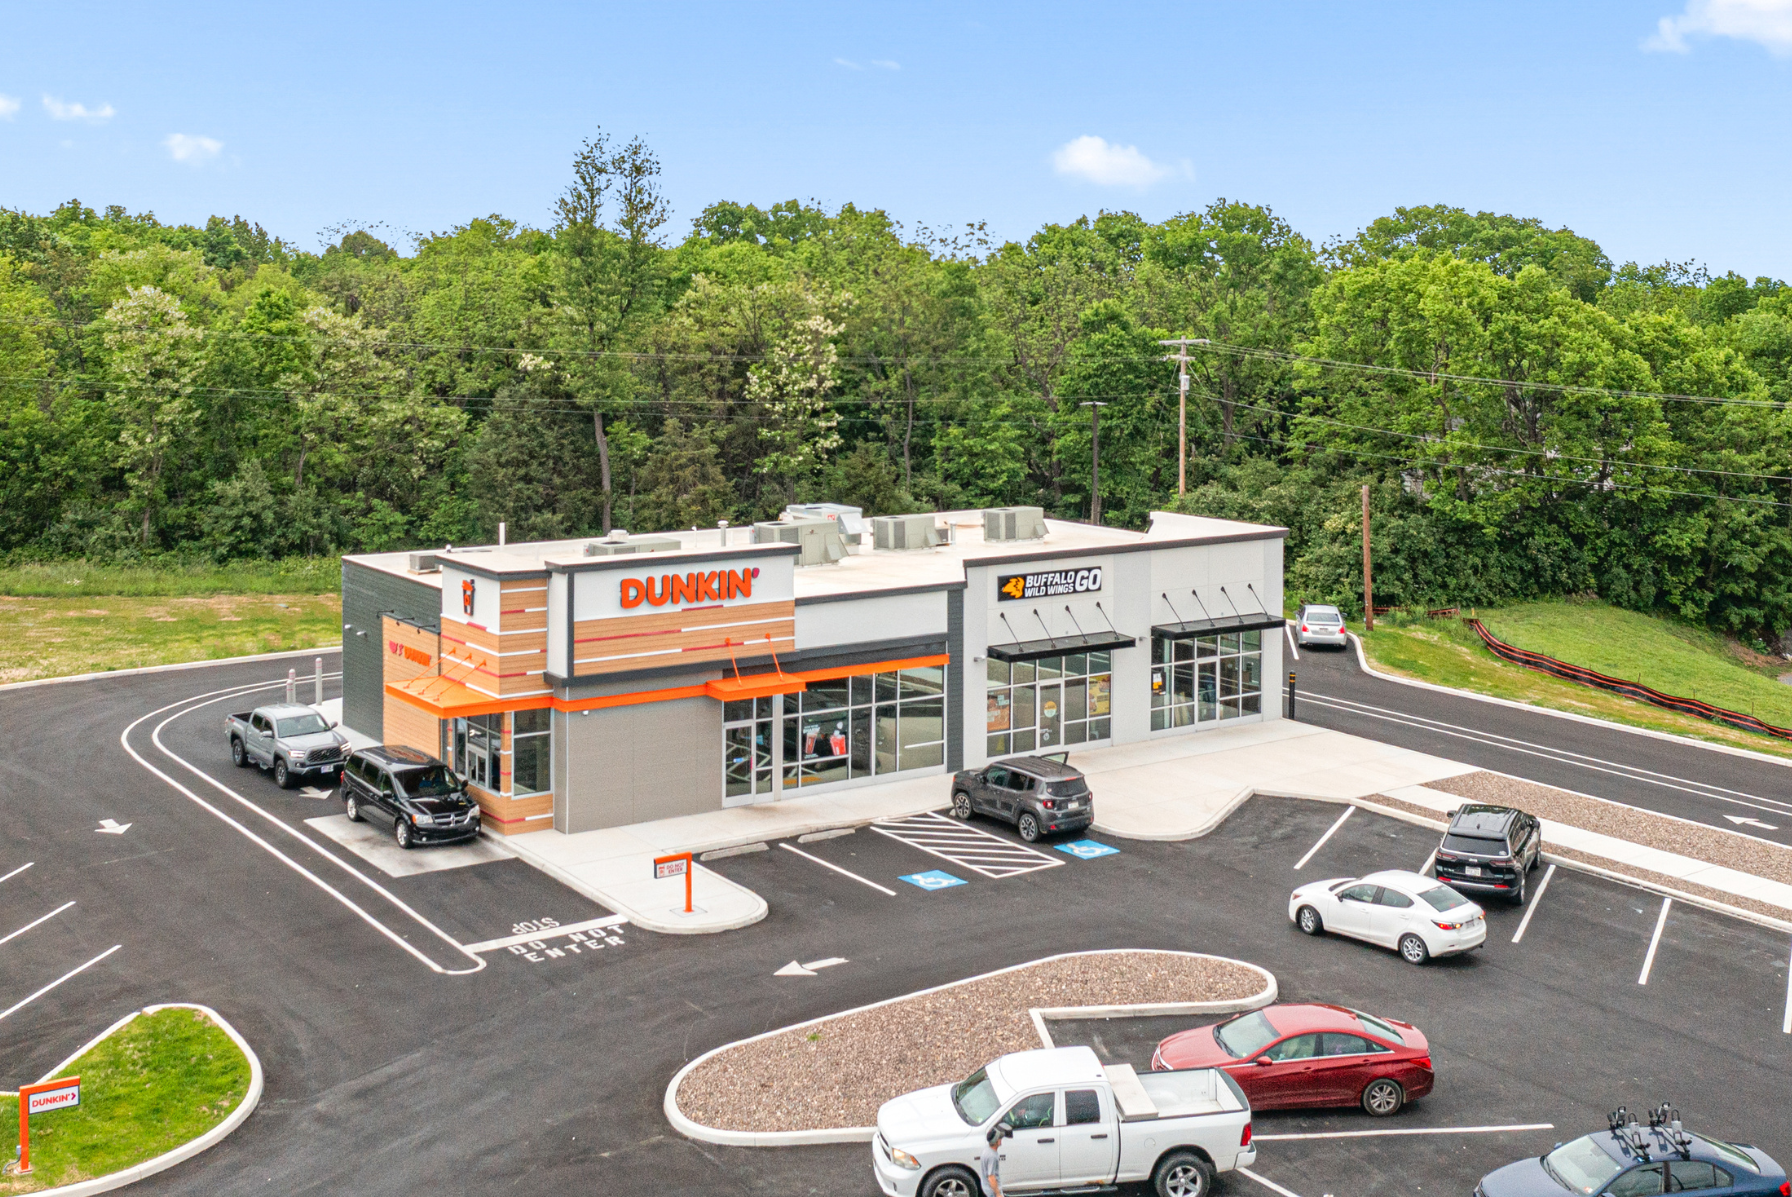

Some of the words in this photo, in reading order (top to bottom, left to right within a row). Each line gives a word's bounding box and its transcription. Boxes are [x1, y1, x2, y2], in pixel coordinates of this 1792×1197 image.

[621, 567, 760, 609] DUNKIN'
[1025, 571, 1075, 588] BUFFALO
[1075, 568, 1102, 592] GO
[1024, 586, 1046, 598] WILD
[1047, 583, 1074, 596] WINGS
[512, 917, 560, 935] STOP
[507, 940, 547, 955] DO
[568, 924, 625, 943] NOT
[523, 935, 627, 962] ENTER
[32, 1093, 71, 1108] DUNKIN'
